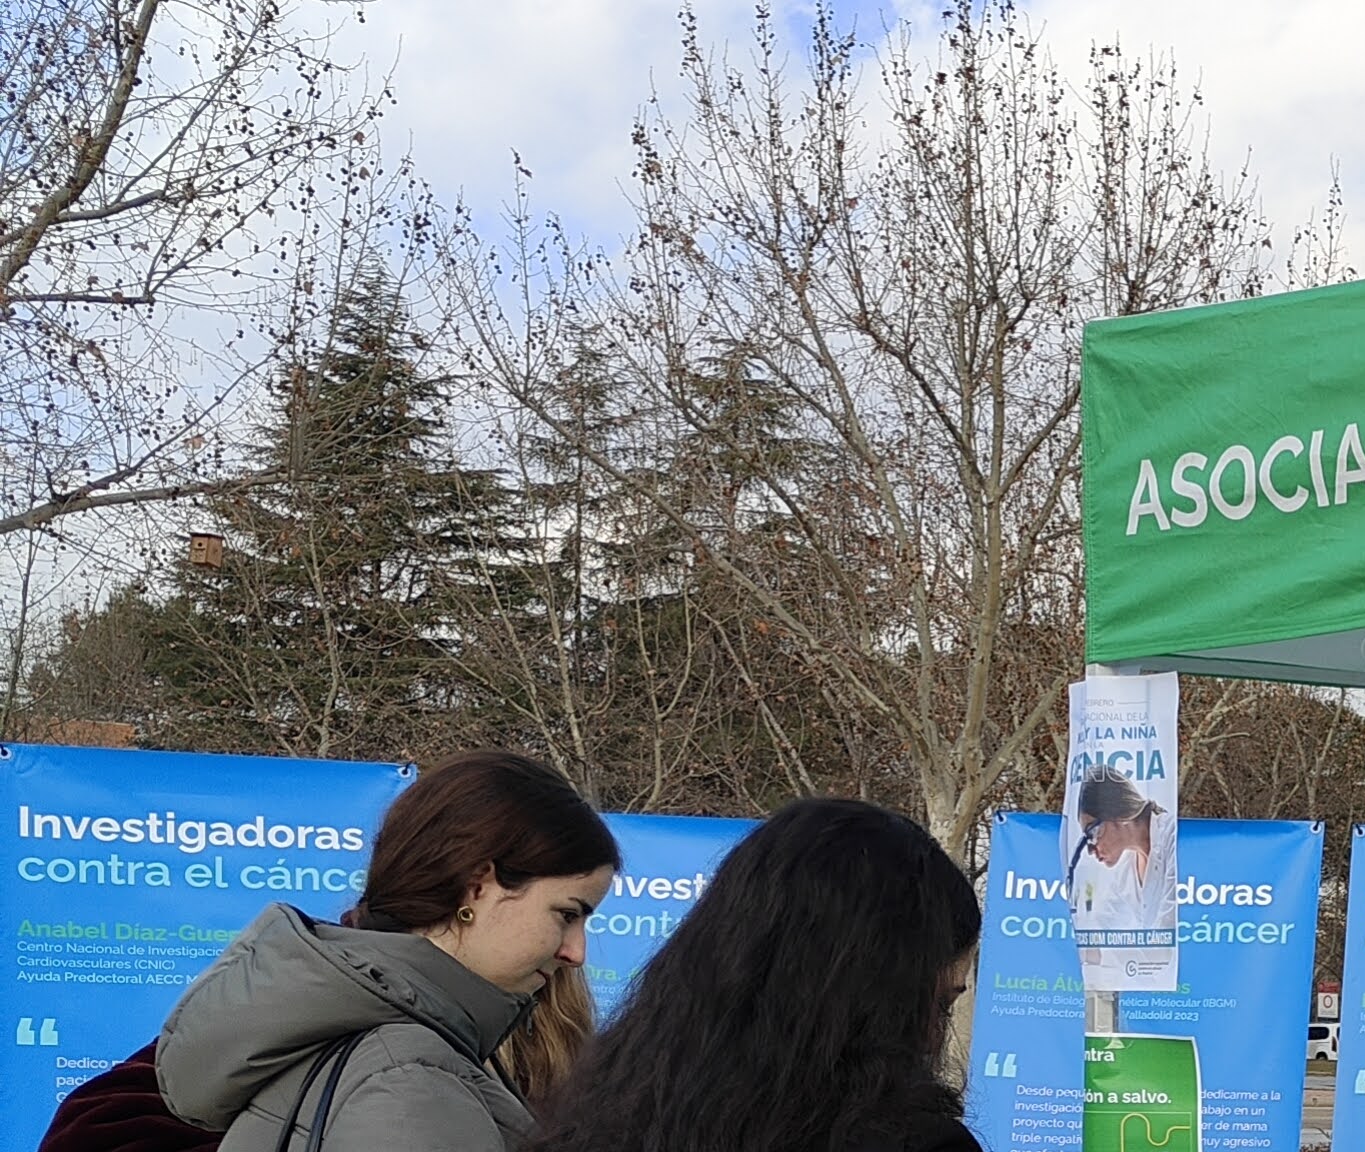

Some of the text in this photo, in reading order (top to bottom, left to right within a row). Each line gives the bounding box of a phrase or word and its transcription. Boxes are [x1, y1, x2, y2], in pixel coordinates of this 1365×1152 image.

[1083, 722, 1157, 740] Y LA NIÑA
[19, 805, 363, 854] Investigadoras
[17, 854, 171, 886] contra
[184, 856, 228, 888] el
[17, 919, 108, 939] Anabel
[1177, 915, 1295, 944] cáncer
[17, 941, 145, 955] Centro Nacional de
[17, 955, 175, 971] Cardiovasculares (CNIC)
[17, 970, 183, 984] Ayuda Predoctoral AECC
[994, 973, 1048, 990] Lucía
[1151, 998, 1236, 1009] Molecular (IBGM)
[1123, 1010, 1199, 1021] Valladolid 2023
[56, 1056, 108, 1069] Dedico
[1108, 1090, 1172, 1104] a salvo.
